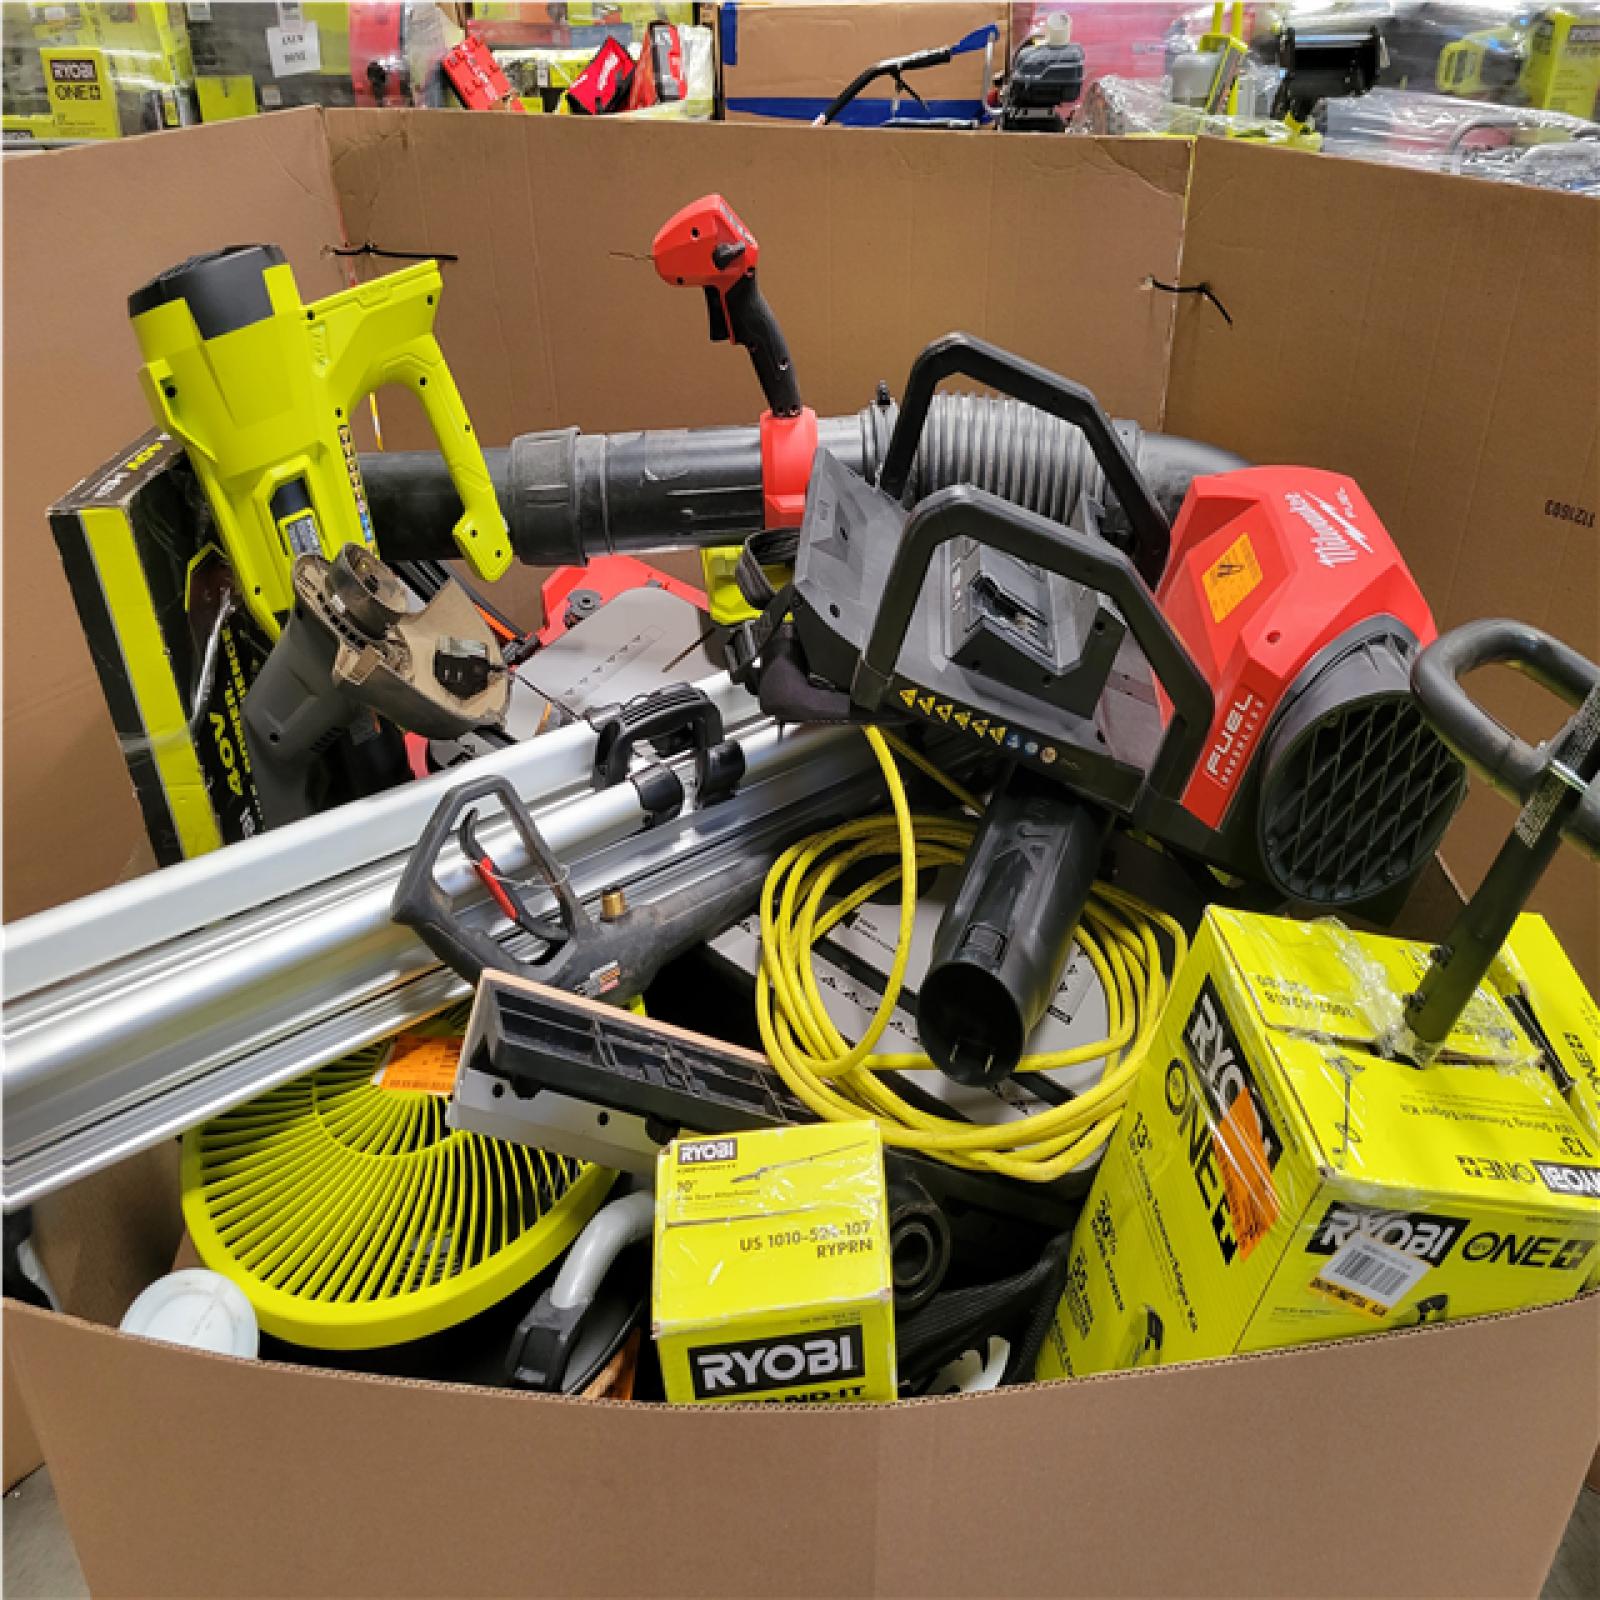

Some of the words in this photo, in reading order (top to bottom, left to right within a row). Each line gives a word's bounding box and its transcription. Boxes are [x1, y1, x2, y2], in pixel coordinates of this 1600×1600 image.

[51, 62, 95, 80] RYOBI
[1206, 694, 1254, 775] FUEL
[681, 1140, 735, 1162] RYOBI
[1538, 1165, 1600, 1196] YOBI
[739, 1236, 763, 1252] US
[817, 1238, 874, 1259] RYPRN
[696, 1333, 852, 1392] RYOBI
